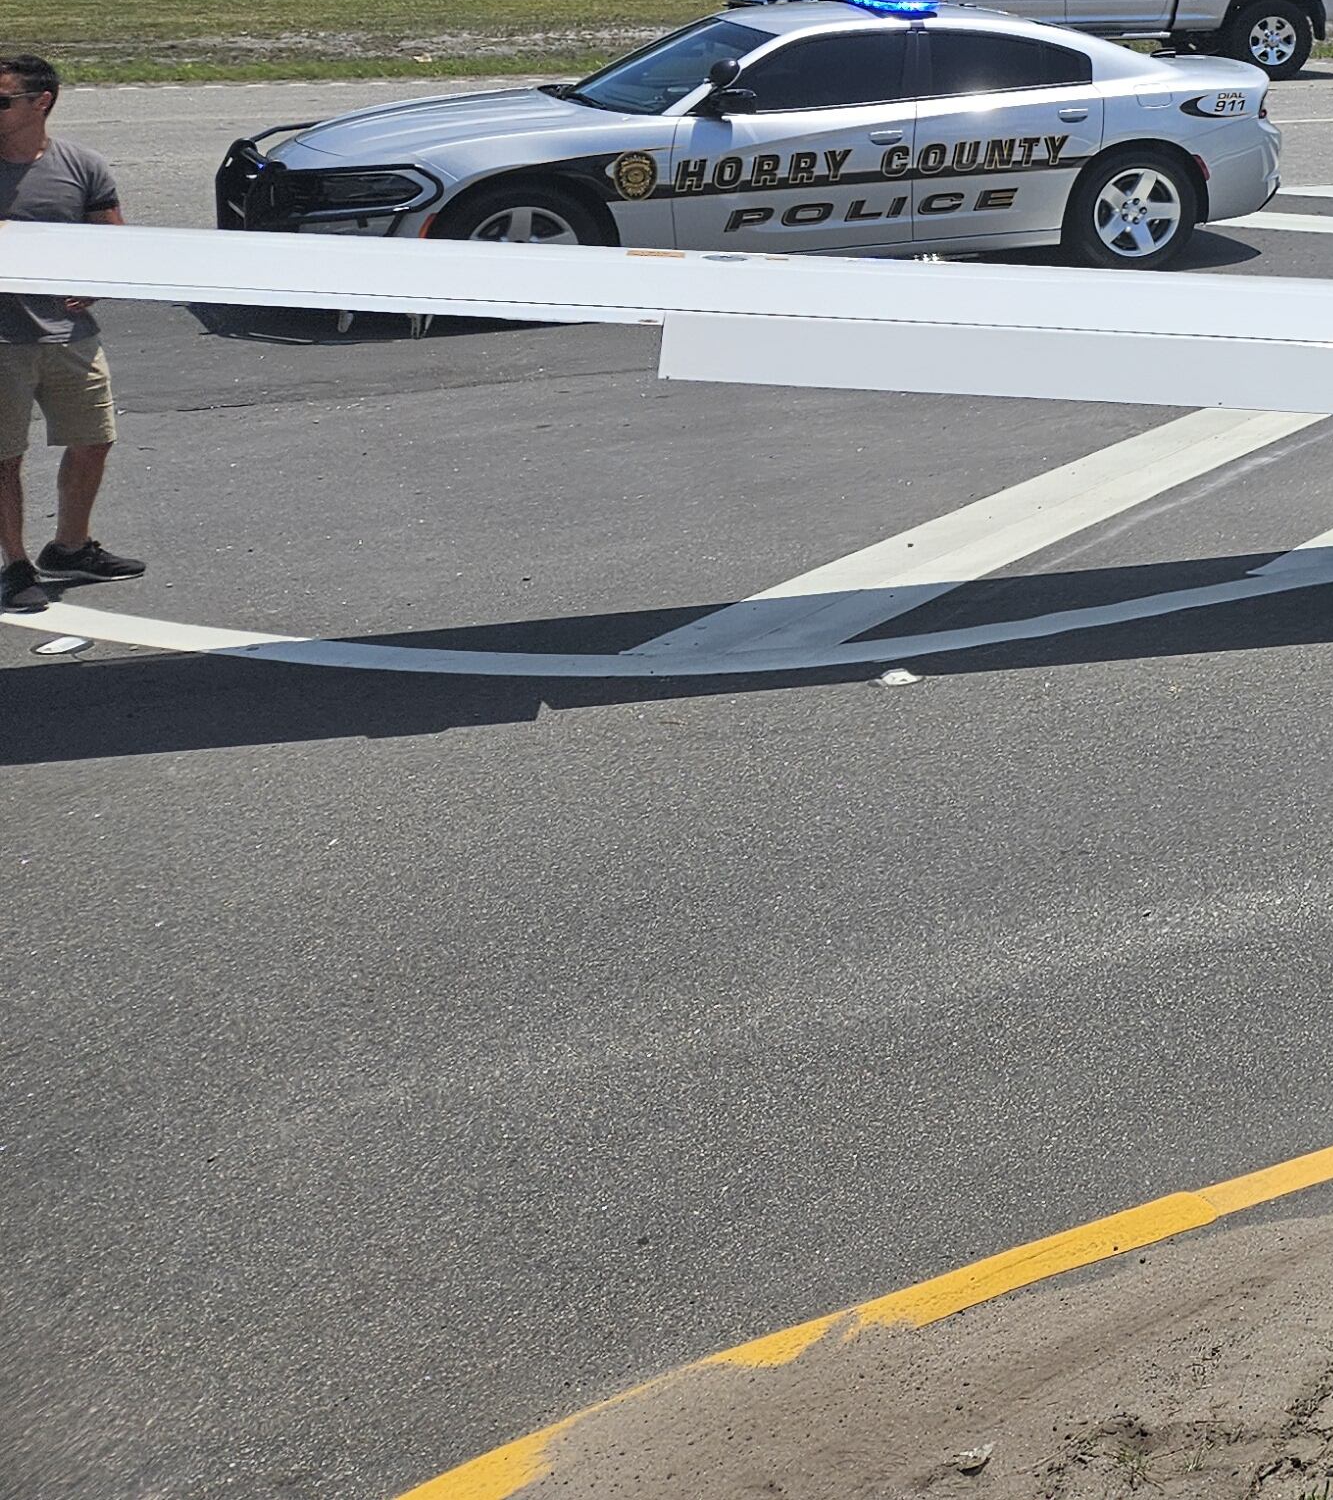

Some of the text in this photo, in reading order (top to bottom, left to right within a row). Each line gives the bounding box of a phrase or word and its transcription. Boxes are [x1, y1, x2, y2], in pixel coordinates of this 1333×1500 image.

[1214, 99, 1246, 112] 911
[1217, 92, 1246, 100] DIAL
[675, 135, 1070, 193] HORRY COUNTY
[724, 187, 1019, 233] POLICE
